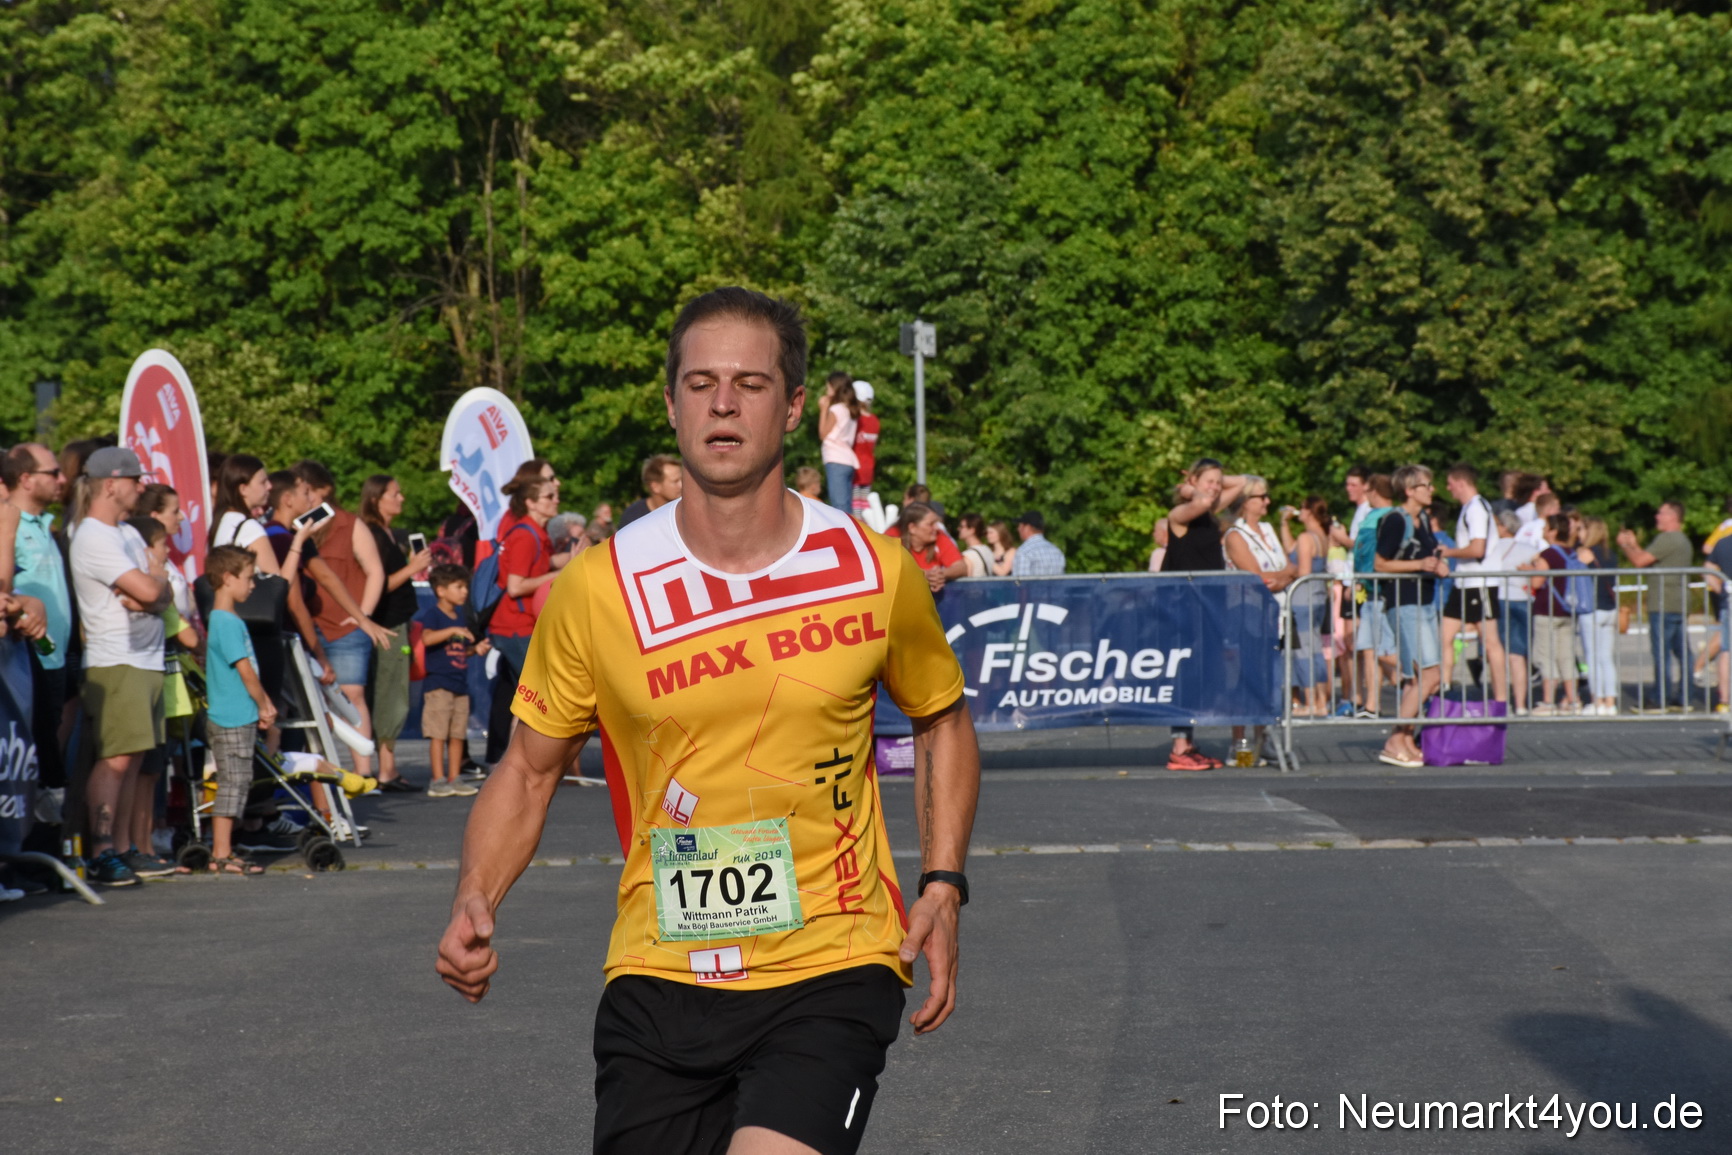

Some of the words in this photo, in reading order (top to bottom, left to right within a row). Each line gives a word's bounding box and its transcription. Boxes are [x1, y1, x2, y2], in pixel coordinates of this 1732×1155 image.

[646, 639, 755, 699] MAX
[766, 611, 886, 661] BÖGL
[979, 639, 1192, 683] Fischer
[517, 683, 548, 715] egl.de
[998, 685, 1174, 708] AUTOMOBILE
[669, 848, 718, 862] firmenlauf
[754, 849, 782, 862] 2019
[669, 862, 777, 909] 1702
[682, 910, 732, 921] Wittmann
[735, 905, 769, 917] Patrik
[692, 922, 708, 931] Bögl
[709, 919, 751, 929] Bauservice
[753, 915, 778, 925] GmbH
